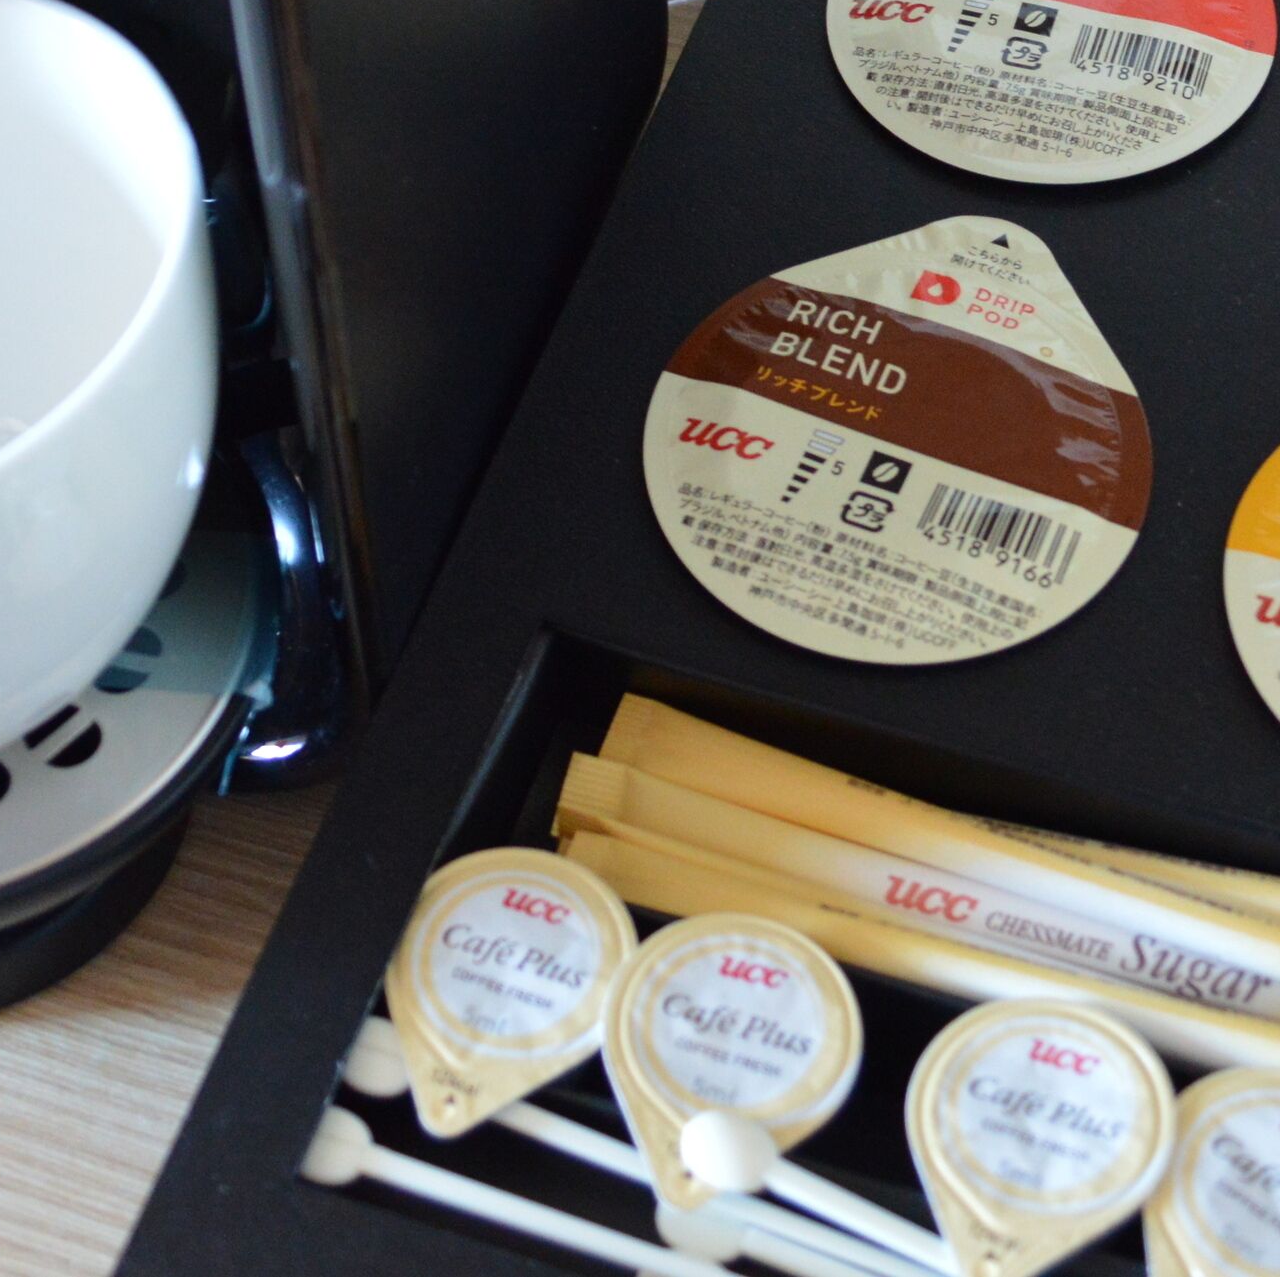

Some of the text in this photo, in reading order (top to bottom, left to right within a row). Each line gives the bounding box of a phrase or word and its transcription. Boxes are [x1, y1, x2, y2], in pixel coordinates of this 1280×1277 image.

[987, 13, 1000, 27] 5
[1075, 59, 1196, 100] 4518 9210
[786, 299, 884, 346] RICH
[965, 302, 1021, 331] POD
[973, 286, 1036, 318] DRIP
[755, 363, 885, 423] リッチブレンド
[769, 332, 908, 397] BLEND
[830, 460, 845, 477] 5
[923, 526, 1053, 589] 4518 9166
[442, 923, 590, 991] Café Plus
[984, 910, 1114, 962] CHESSMATE
[1120, 933, 1272, 1005] Sugar
[662, 991, 813, 1058] Café Plus
[968, 1075, 1044, 1120] Café
[1051, 1100, 1128, 1141] Plus
